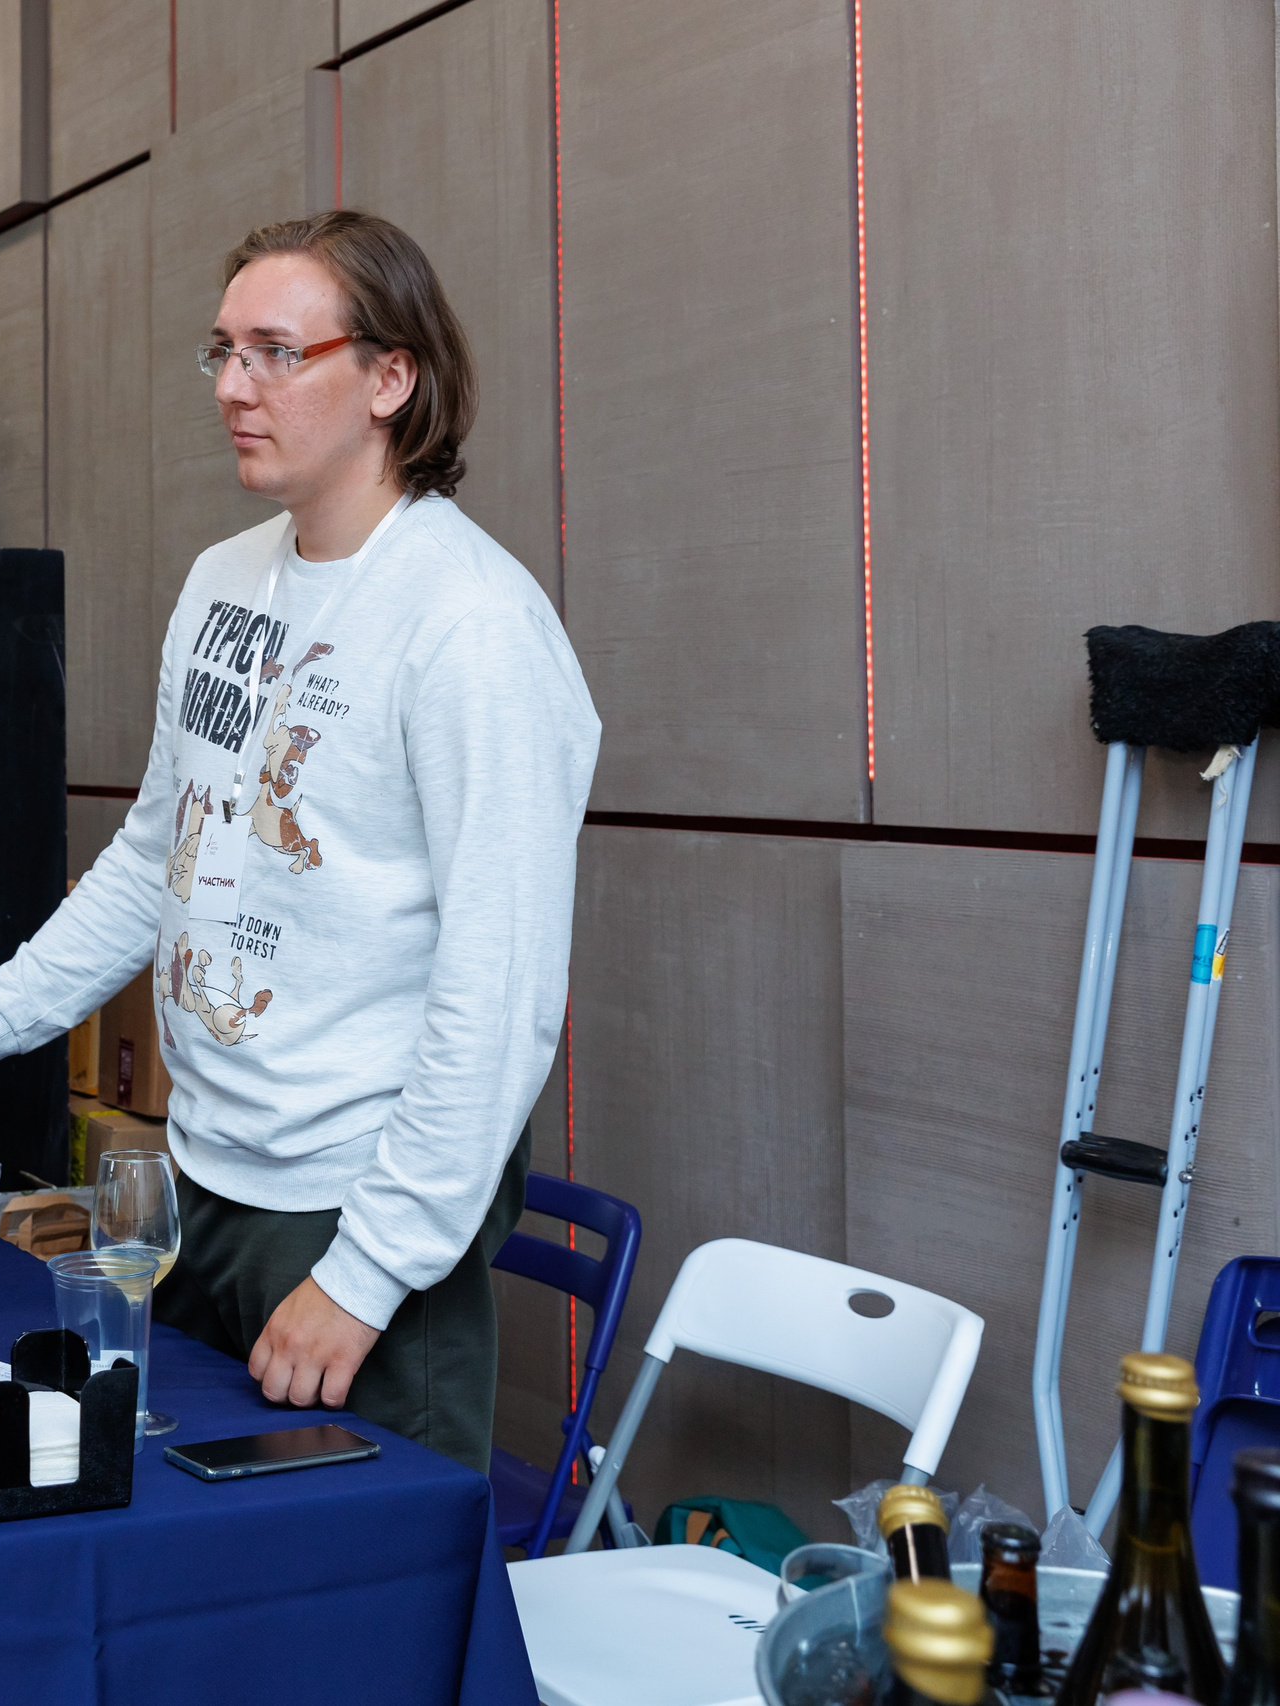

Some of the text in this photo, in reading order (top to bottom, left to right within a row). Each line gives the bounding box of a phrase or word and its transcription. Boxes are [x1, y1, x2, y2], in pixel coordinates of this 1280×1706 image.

[306, 673, 340, 695] WHAT?
[296, 691, 350, 719] ALREADY?
[198, 875, 236, 888] УЧАСТНИК
[245, 916, 282, 941] DOWN
[230, 932, 277, 961] TO REST
